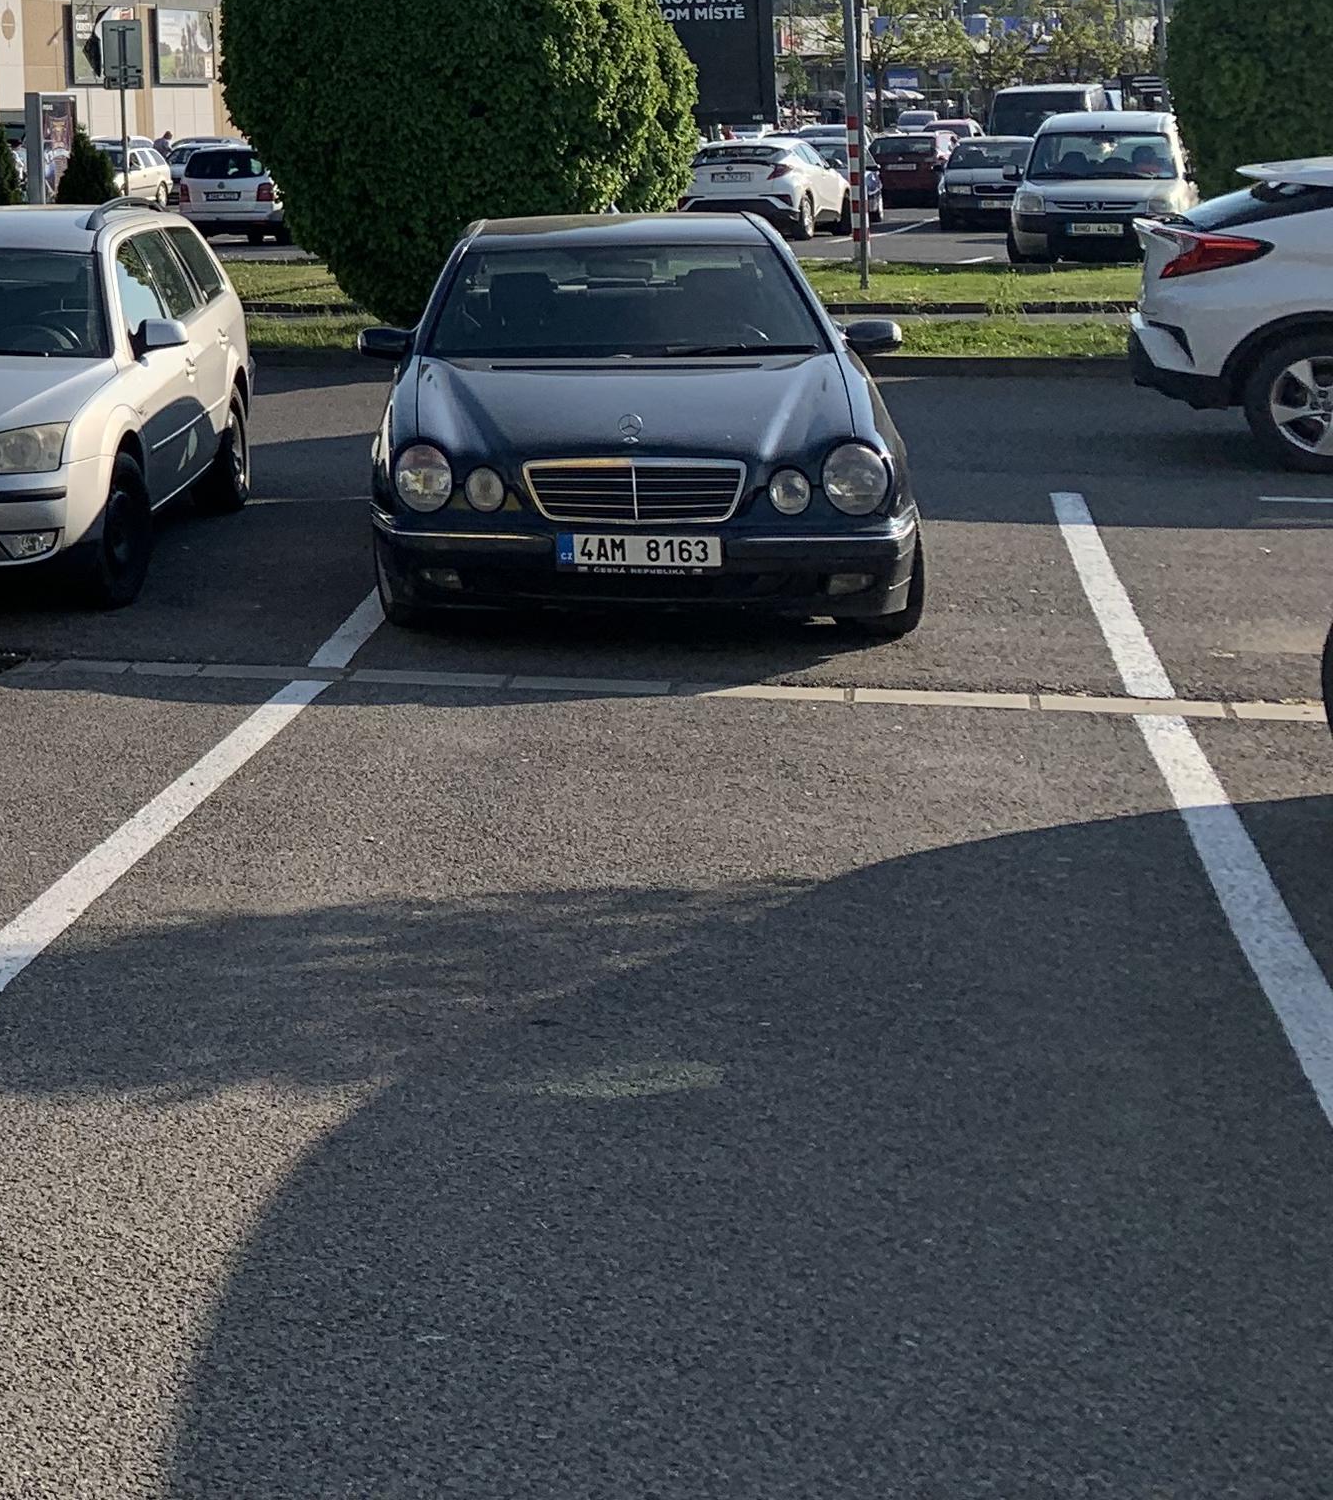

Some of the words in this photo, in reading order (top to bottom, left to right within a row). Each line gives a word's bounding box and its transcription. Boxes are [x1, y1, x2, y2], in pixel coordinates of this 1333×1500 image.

[663, 8, 690, 20] OM
[694, 4, 745, 20] MÍSTĚ
[560, 552, 573, 560] CZ
[580, 537, 626, 562] 4AM
[646, 539, 709, 563] 8163
